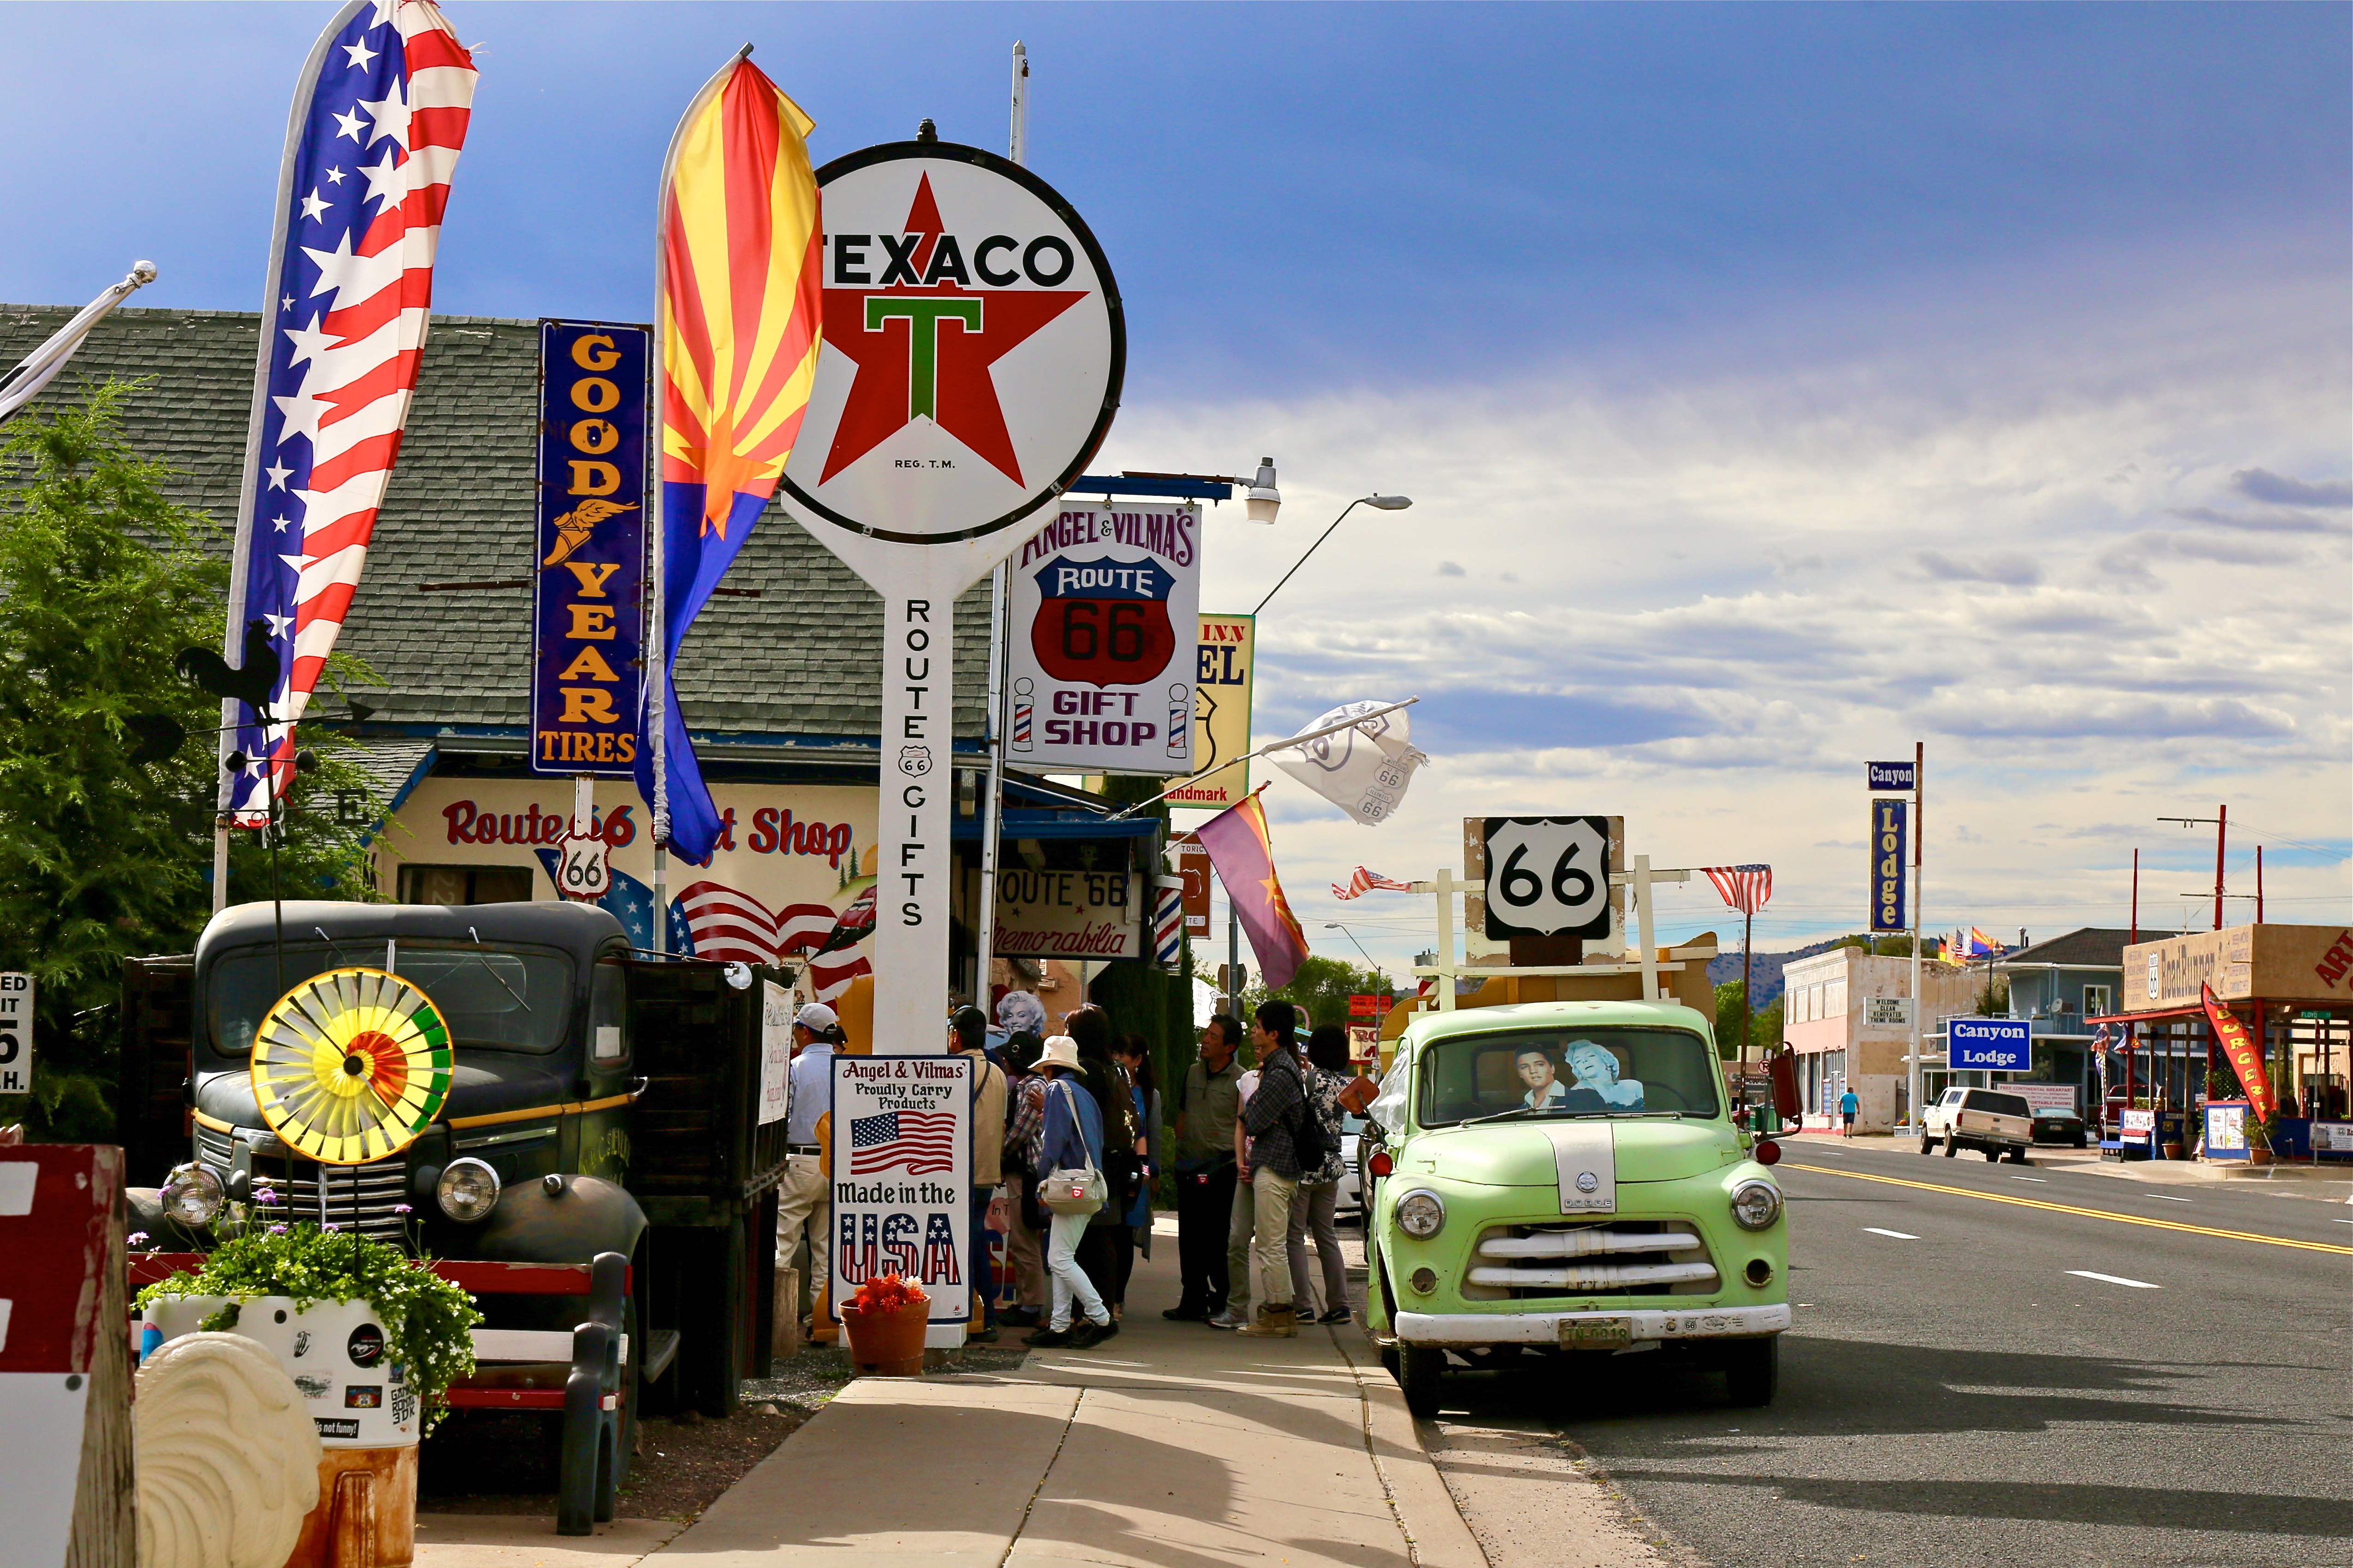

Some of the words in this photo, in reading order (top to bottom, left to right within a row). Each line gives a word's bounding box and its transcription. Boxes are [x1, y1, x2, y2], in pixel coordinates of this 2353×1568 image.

[823, 234, 1074, 287] EXACO
[567, 335, 621, 496] GOOD
[895, 460, 924, 468] REG.
[1101, 519, 1113, 537] &
[1110, 507, 1193, 567] VILMA'S
[1057, 567, 1153, 598] ROUTE
[558, 562, 621, 724] YEAR
[1063, 601, 1144, 662] 66
[1202, 624, 1246, 643] INN
[904, 599, 930, 739] ROUTE
[1197, 644, 1244, 685] EL
[1053, 690, 1141, 717] GIFT
[538, 731, 636, 762] TIRES
[1044, 719, 1157, 747] SHOP
[904, 760, 925, 772] 66
[1379, 770, 1398, 786] 66
[1870, 765, 1913, 785] Canyon
[1369, 790, 1389, 801] ILLINOIS
[442, 799, 563, 845] Route
[1362, 802, 1382, 817] 66
[748, 807, 853, 870] Shop
[566, 850, 602, 887] 66
[901, 785, 926, 926] GIFTS
[1881, 807, 1898, 925] Lodge
[1499, 842, 1595, 908] 66
[0, 976, 27, 991] ED
[2150, 969, 2157, 993] 66
[0, 998, 19, 1013] IT
[0, 1020, 19, 1064] 5
[1954, 1023, 2025, 1042] Canyon
[1963, 1049, 2017, 1066] Lodge
[843, 1061, 890, 1082] Angel
[894, 1061, 909, 1078] &
[855, 1082, 906, 1098] Proudly
[912, 1084, 952, 1099] Carry
[879, 1097, 936, 1109] Products
[837, 1182, 895, 1204] Made
[899, 1182, 917, 1203] in
[919, 1182, 955, 1204] the
[839, 1213, 962, 1286] USA
[324, 1423, 335, 1433] not
[336, 1422, 357, 1436] funny!
